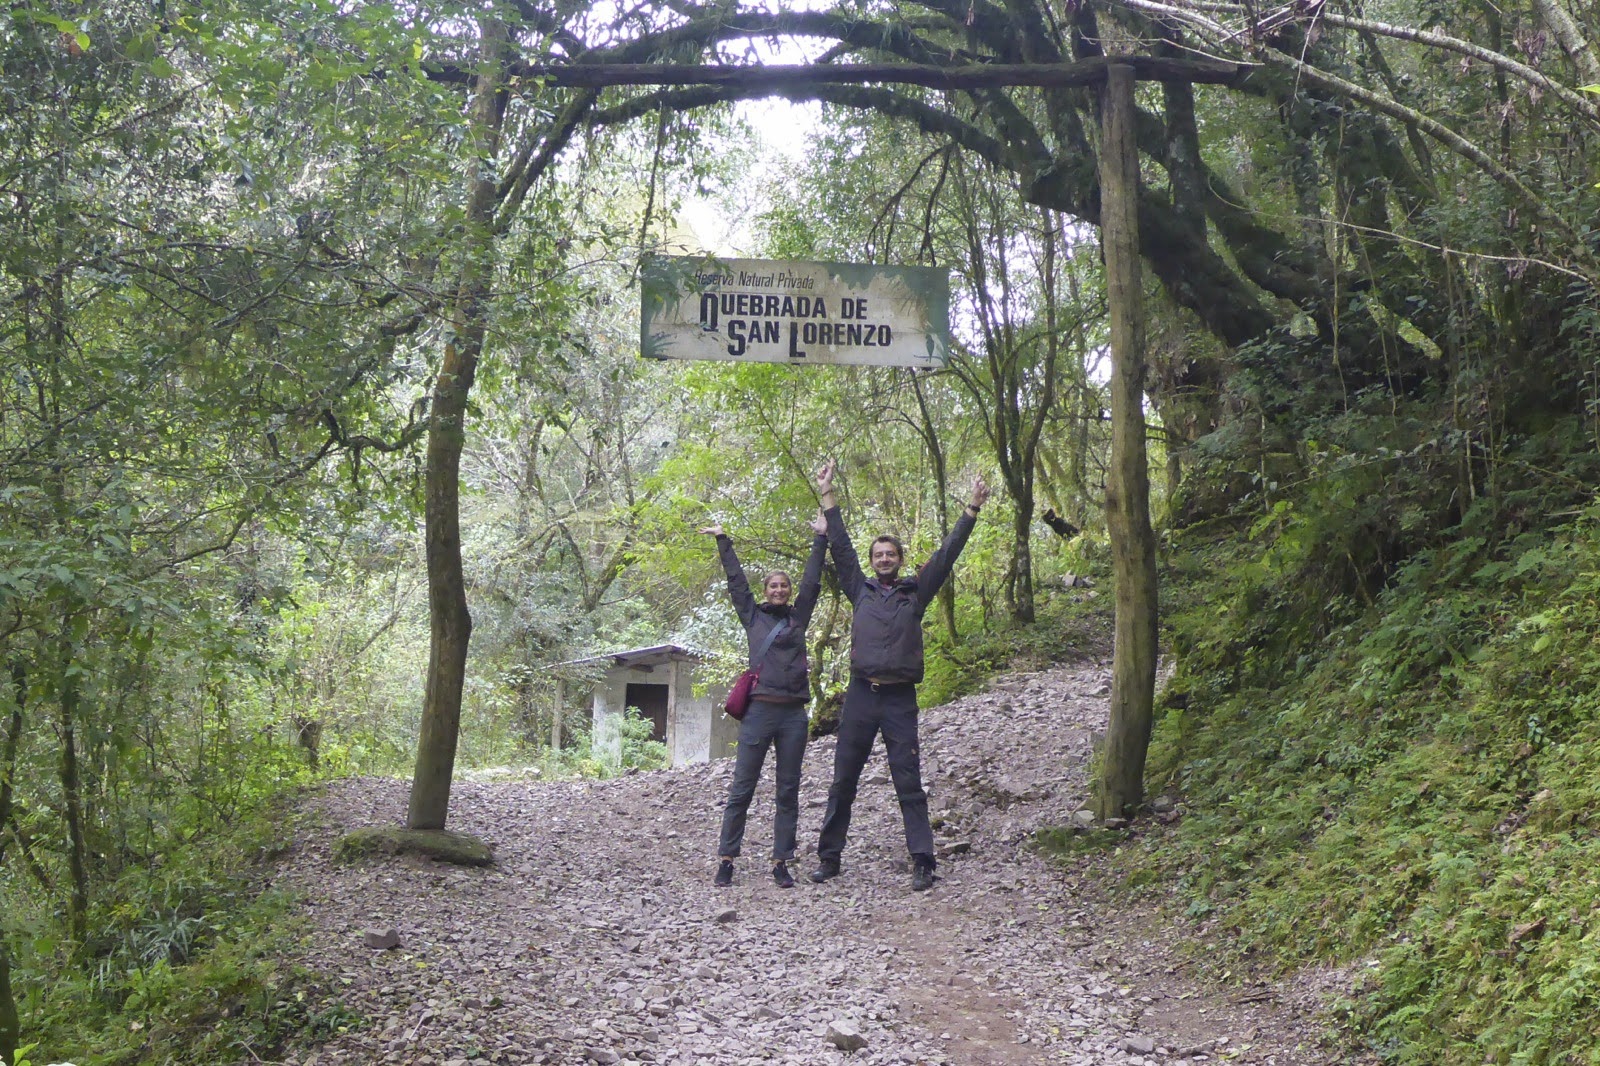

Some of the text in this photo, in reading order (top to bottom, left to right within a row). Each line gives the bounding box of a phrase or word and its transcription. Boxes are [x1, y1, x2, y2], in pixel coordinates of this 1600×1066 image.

[695, 269, 815, 290] Reserva Natural Privada
[700, 293, 868, 332] QUEBRADA DE
[727, 319, 892, 358] SAN LORENZO
